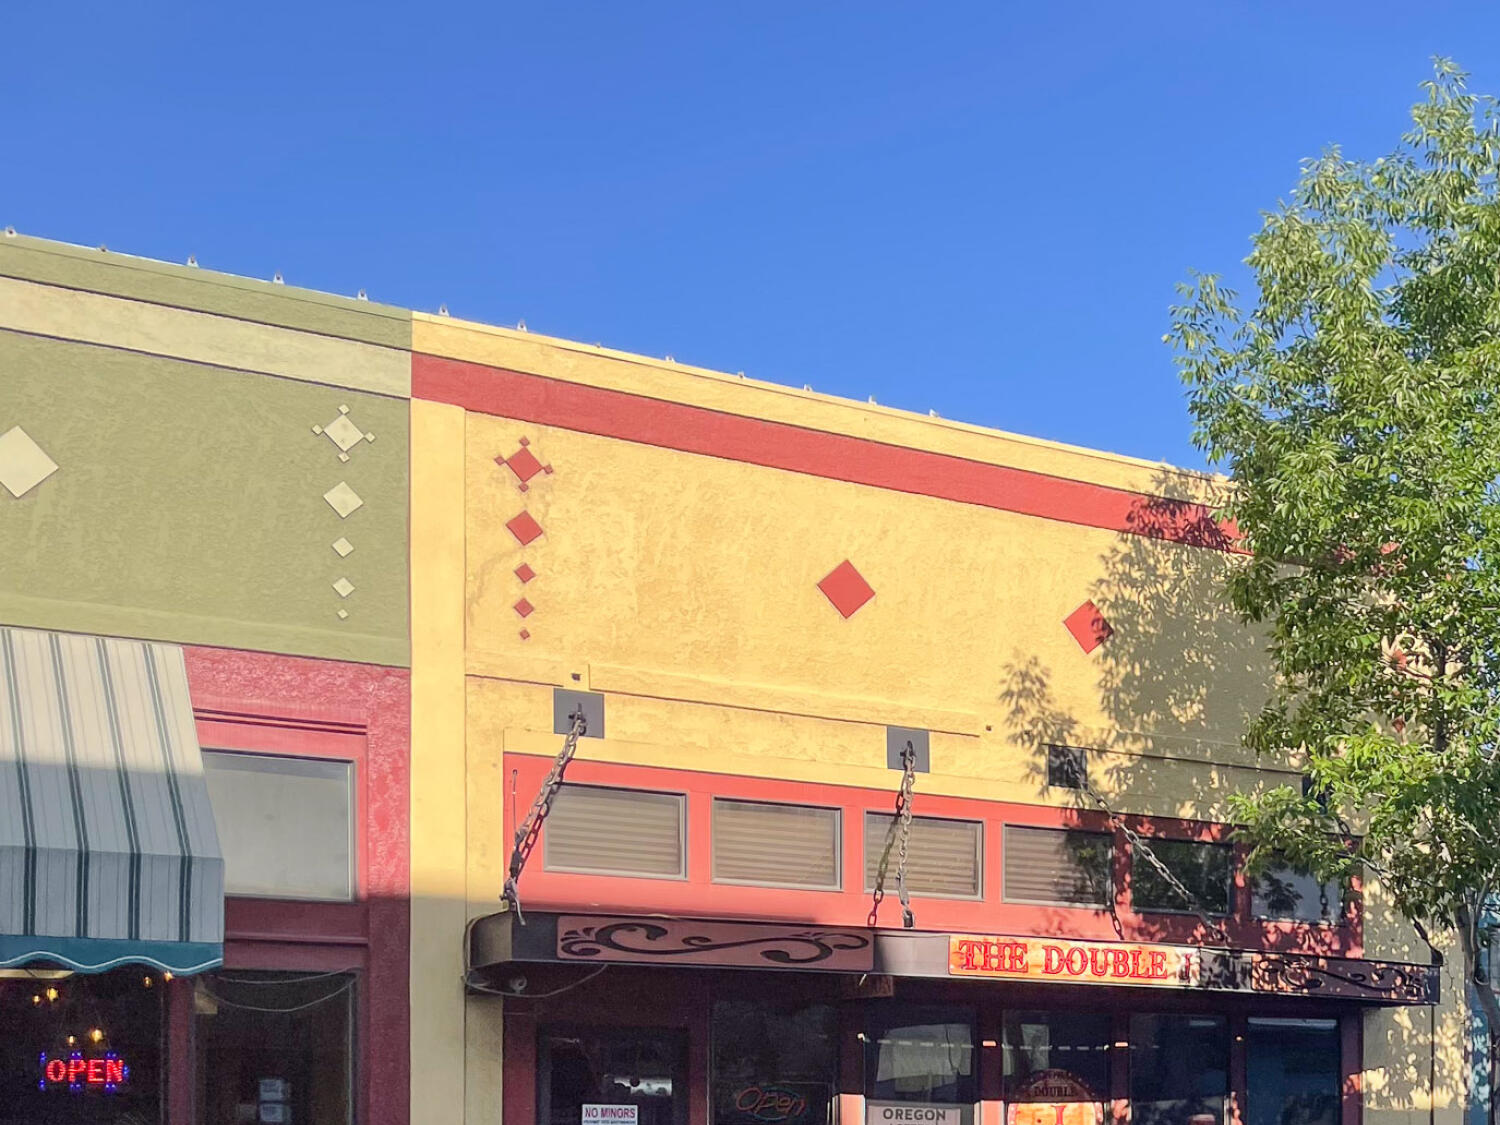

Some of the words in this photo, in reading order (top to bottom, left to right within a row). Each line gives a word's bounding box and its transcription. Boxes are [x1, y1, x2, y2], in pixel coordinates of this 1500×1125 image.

[958, 939, 1029, 973] THE
[1042, 945, 1168, 980] DOUBLE
[46, 1059, 124, 1082] OPEN
[585, 1107, 599, 1118] NO
[600, 1107, 636, 1119] MINORS
[736, 1087, 806, 1117] Open
[883, 1108, 946, 1121] OREGON
